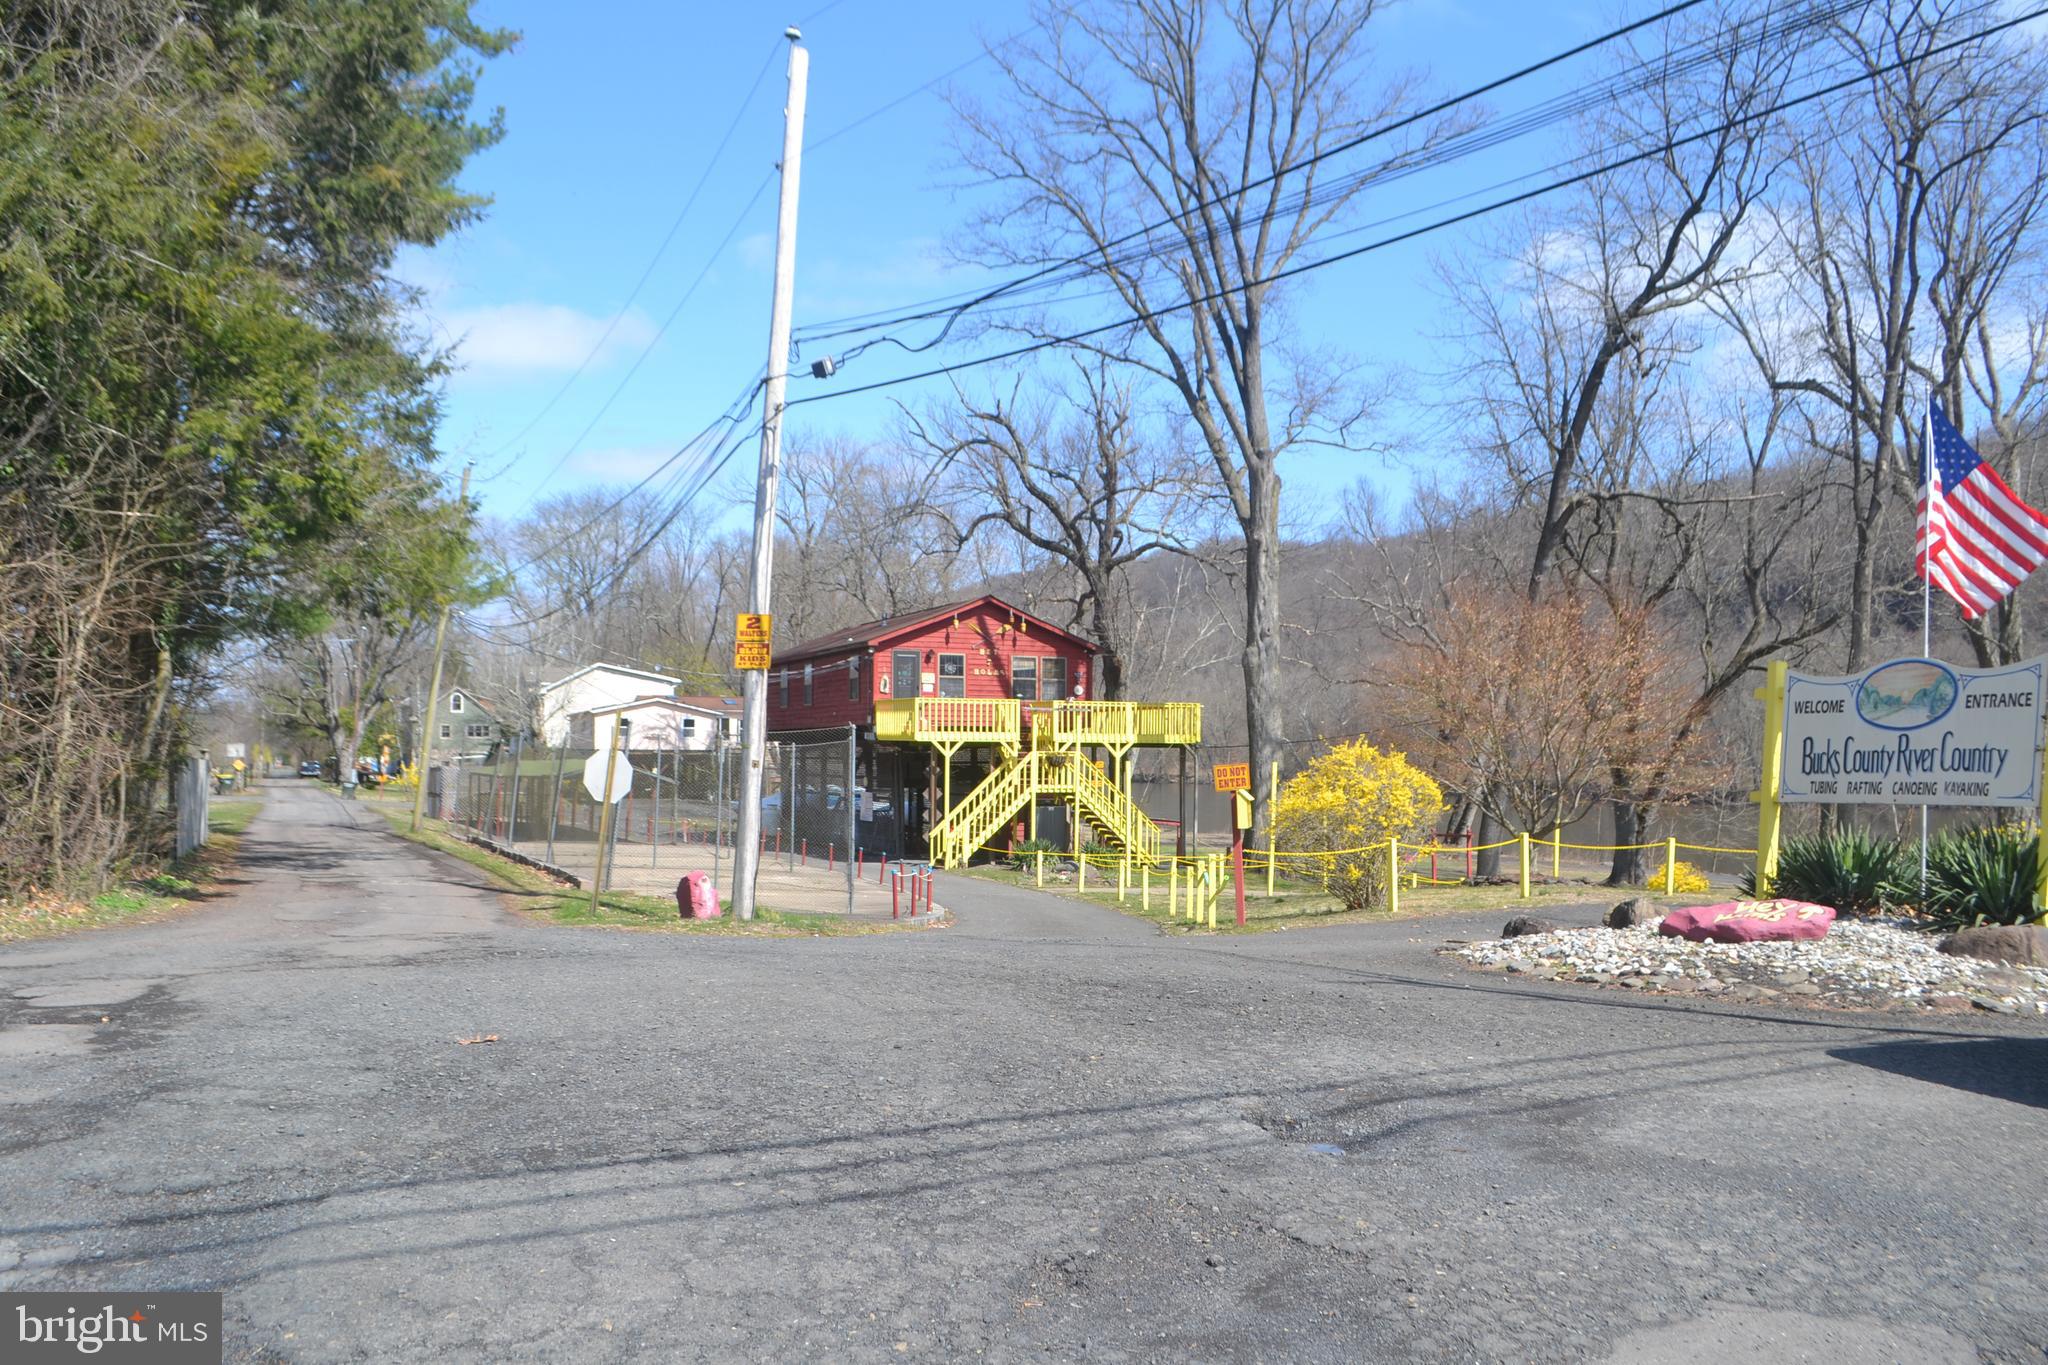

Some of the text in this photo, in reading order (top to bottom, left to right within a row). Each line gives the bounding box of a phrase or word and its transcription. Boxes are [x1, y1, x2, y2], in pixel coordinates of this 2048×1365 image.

[746, 617, 761, 629] 2
[1793, 699, 1846, 715] WELCOME
[1964, 692, 2033, 709] ENTRANCE
[1801, 730, 2009, 779] Bucks County River Country
[1217, 767, 1246, 778] DO NOT
[1218, 778, 1247, 788] ENTER
[1809, 780, 1990, 798] TUBING RAFTING CANOEING KAYAKING
